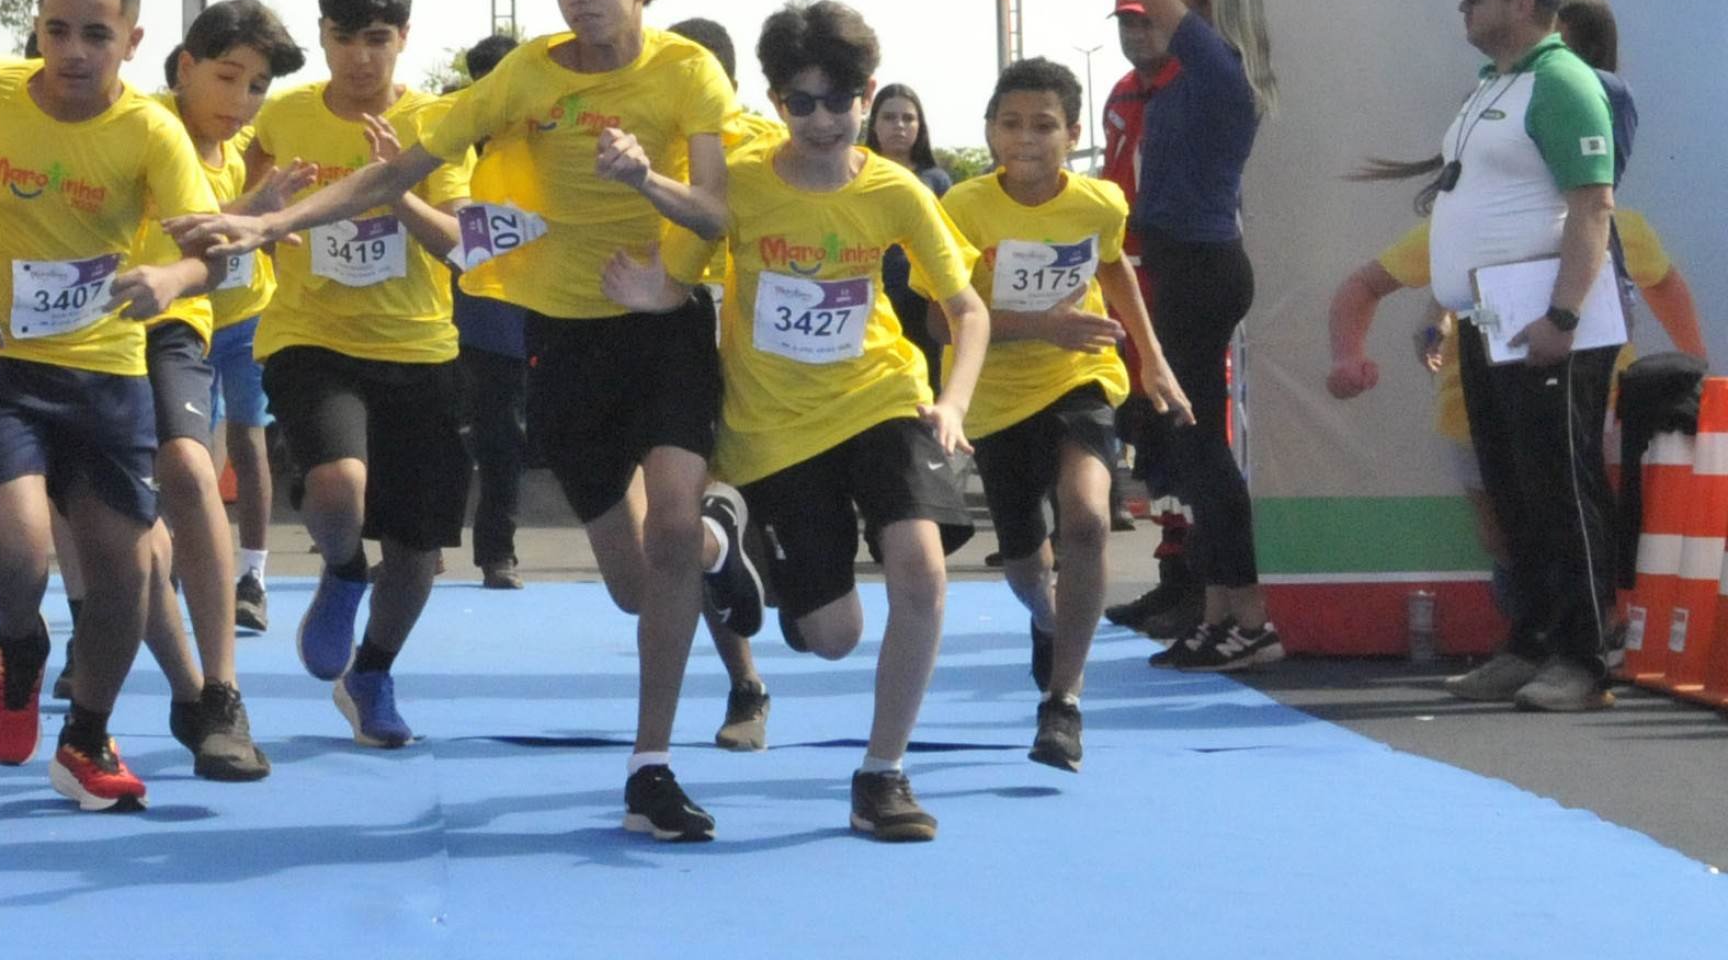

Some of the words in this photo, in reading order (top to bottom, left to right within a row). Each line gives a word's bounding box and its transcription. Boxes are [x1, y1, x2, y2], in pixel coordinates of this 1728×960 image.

[327, 236, 386, 264] 3419
[1012, 266, 1081, 291] 3175
[32, 280, 106, 312] 3407
[773, 306, 852, 337] 3427
